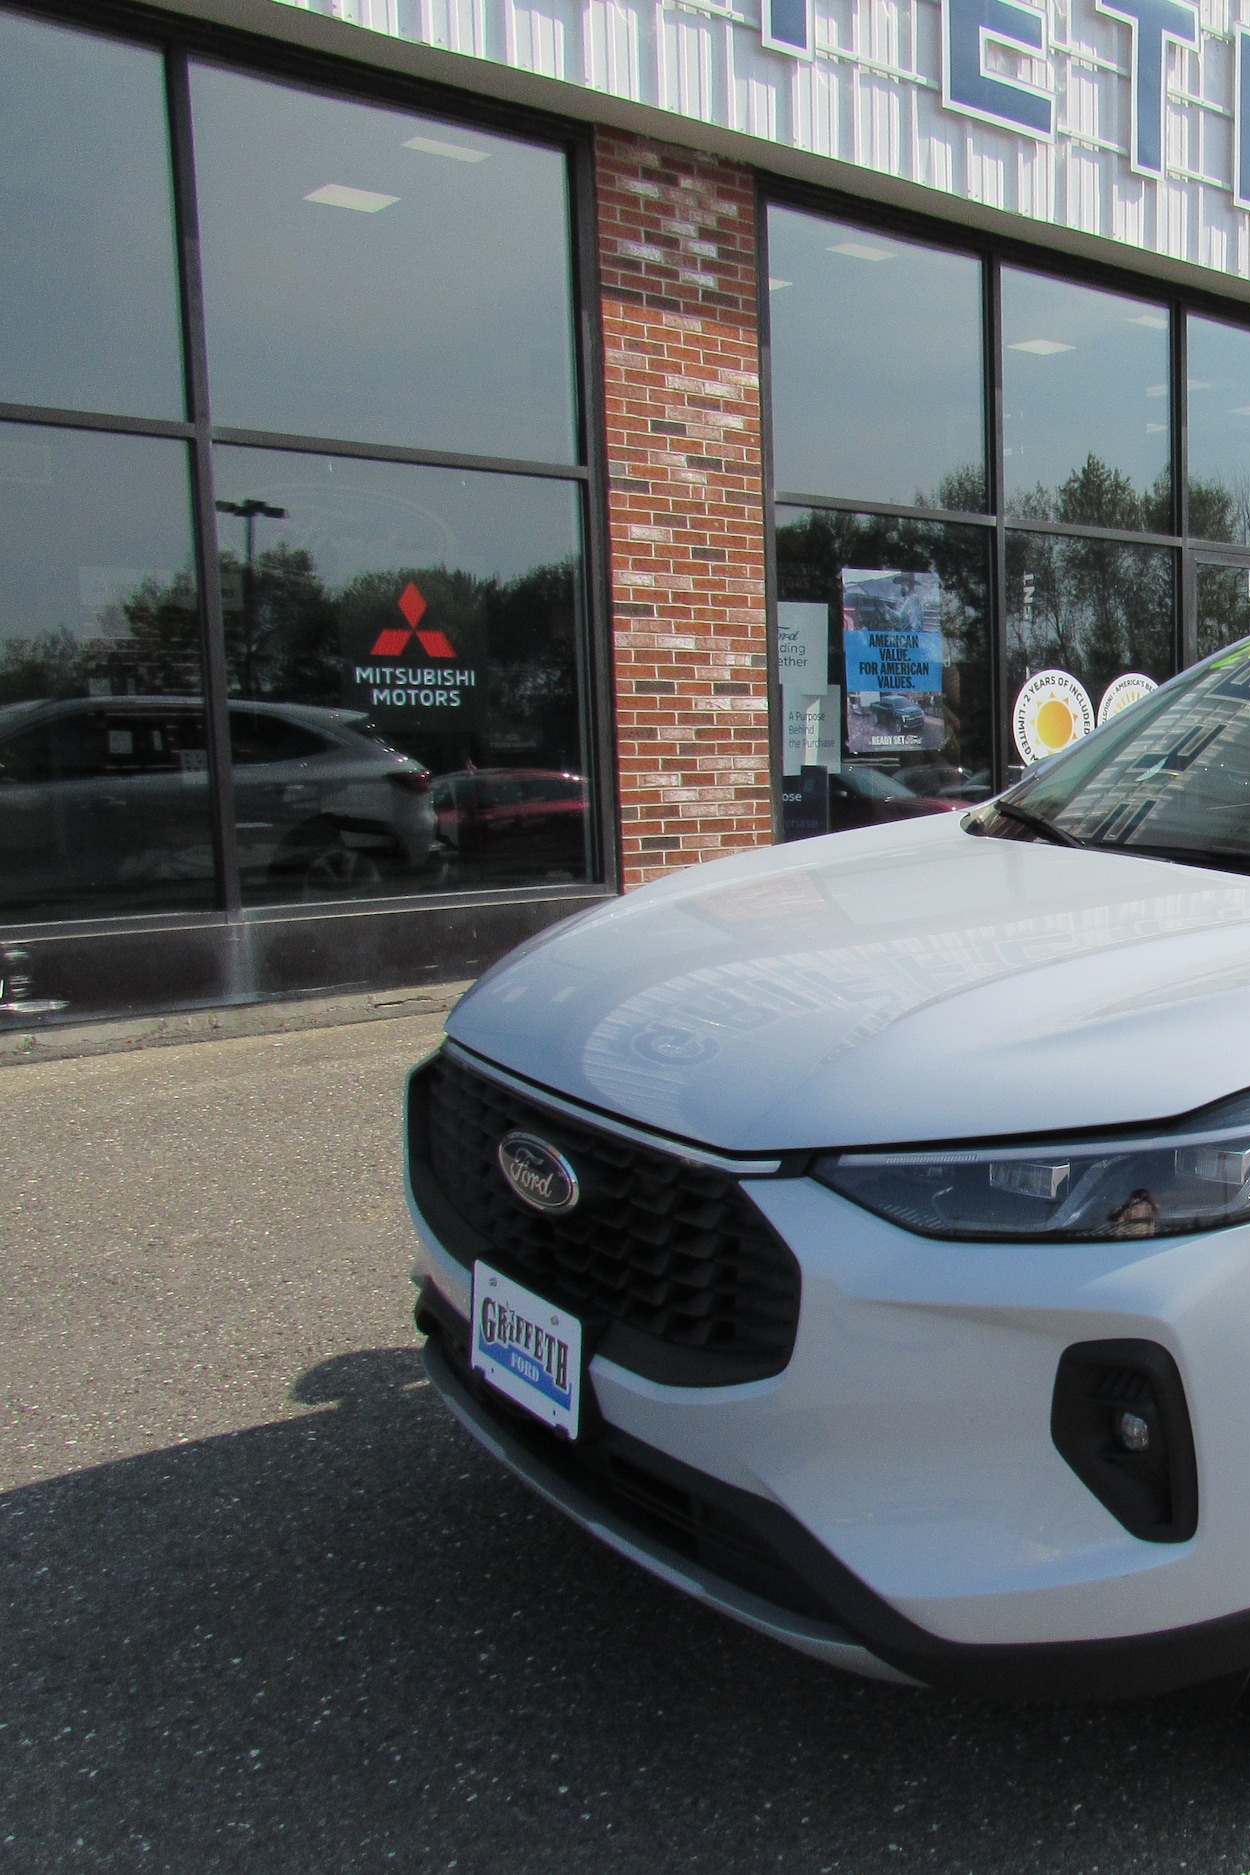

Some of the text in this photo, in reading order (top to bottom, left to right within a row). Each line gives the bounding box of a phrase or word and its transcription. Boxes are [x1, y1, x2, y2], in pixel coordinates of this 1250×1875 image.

[869, 634, 919, 648] AMERICAN
[879, 649, 912, 662] VALUE.
[859, 661, 930, 676] FOR AMERICAN
[355, 667, 476, 687] MITSUBISHI
[877, 676, 916, 690] VALUES.
[1114, 679, 1145, 694] AMERICA'S
[372, 688, 462, 707] MOTORS
[1023, 675, 1091, 736] 2 YEARS OF INCLUDED
[788, 710, 826, 723] A Purpose
[788, 724, 815, 735] Behind
[1017, 708, 1033, 756] LIMITED
[788, 737, 836, 749] the Purchase
[871, 735, 893, 746] READY
[893, 735, 906, 746] SET
[510, 1148, 556, 1198] Ford
[481, 1296, 570, 1391] GRIFFETH
[510, 1350, 540, 1383] FORD
